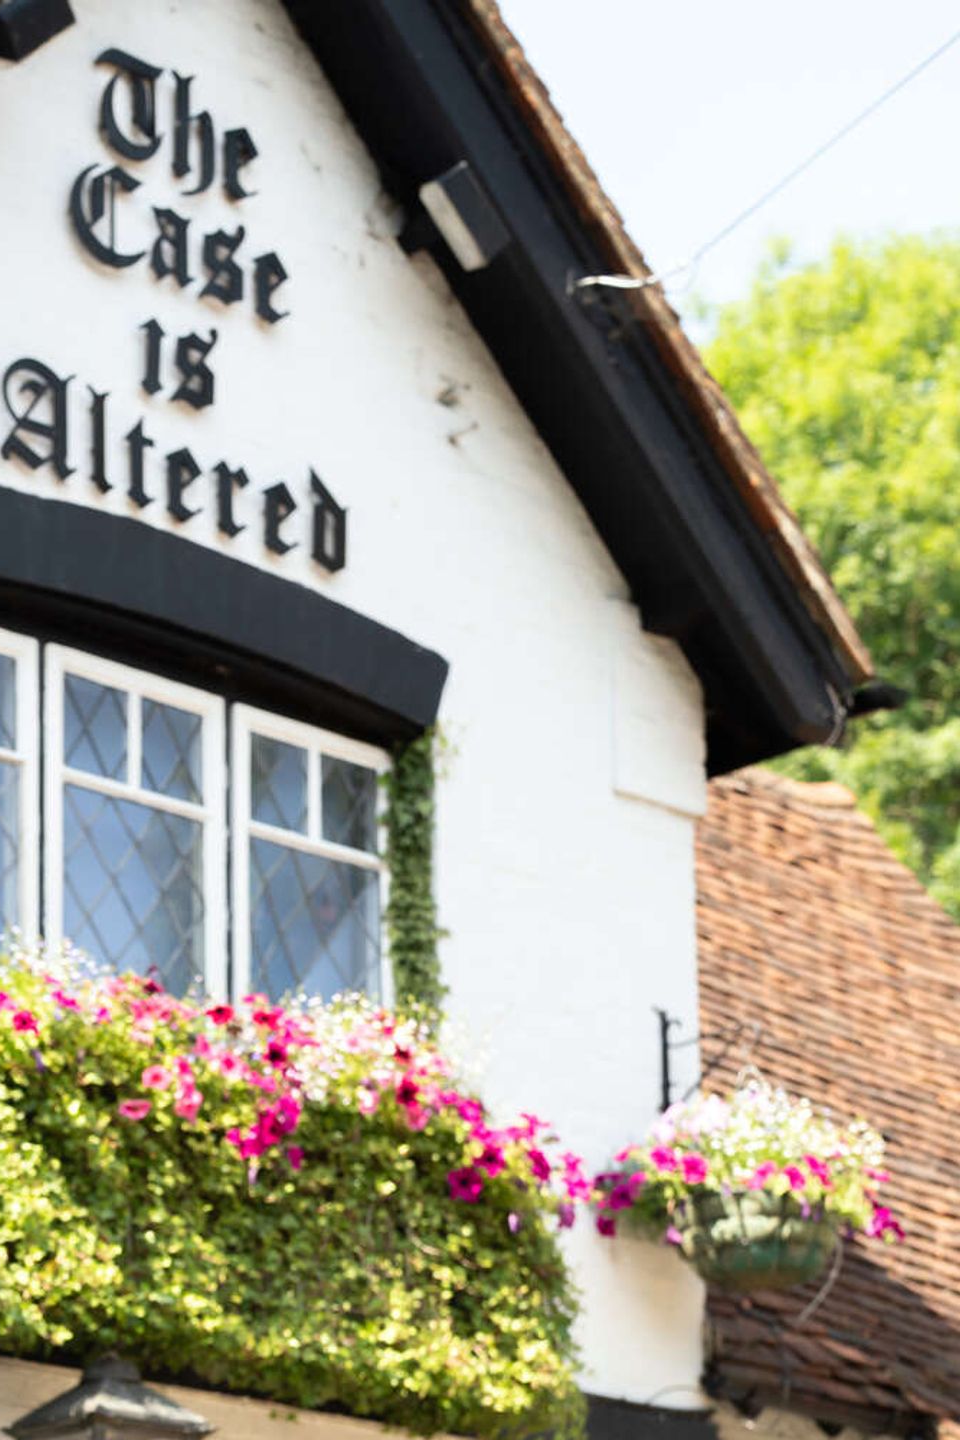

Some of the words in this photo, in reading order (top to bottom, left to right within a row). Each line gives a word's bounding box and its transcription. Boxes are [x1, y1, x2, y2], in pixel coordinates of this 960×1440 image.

[94, 48, 258, 203] The
[68, 164, 290, 324] Case
[1, 358, 347, 574] Altered
